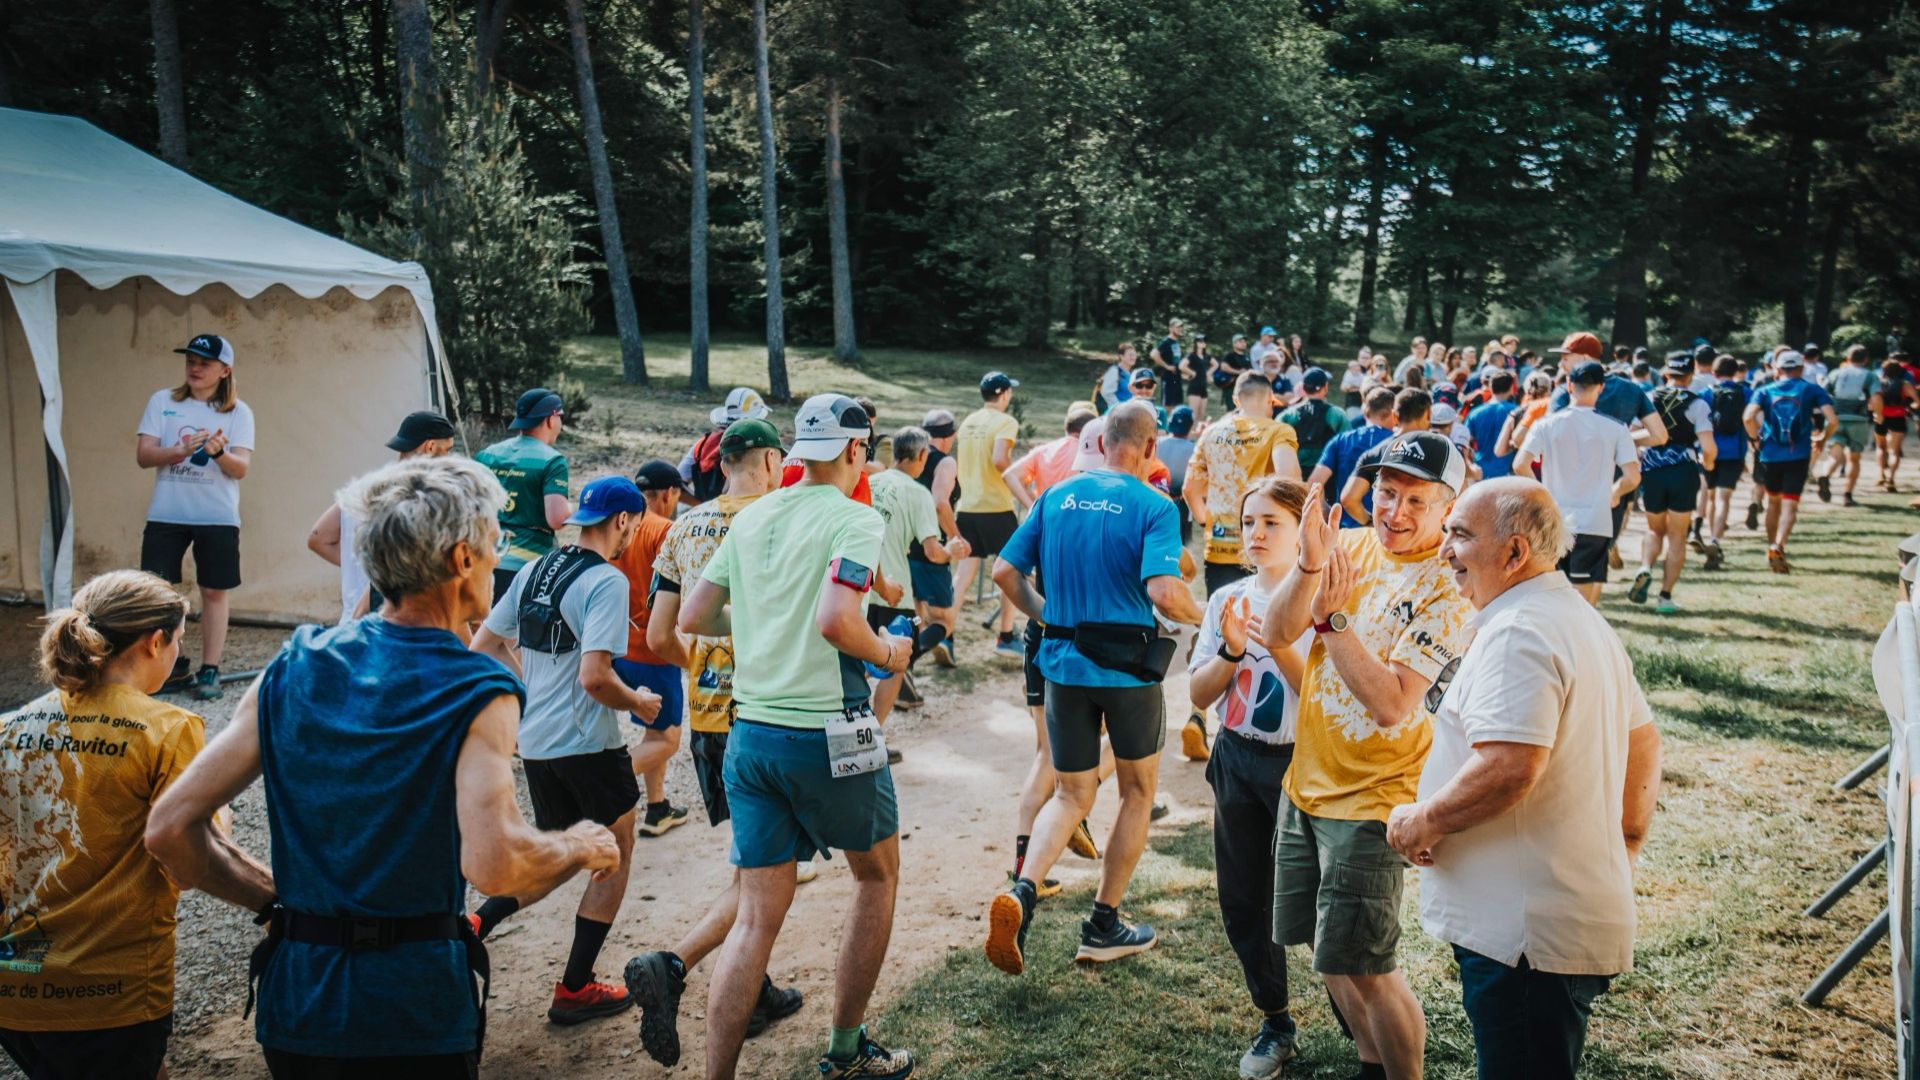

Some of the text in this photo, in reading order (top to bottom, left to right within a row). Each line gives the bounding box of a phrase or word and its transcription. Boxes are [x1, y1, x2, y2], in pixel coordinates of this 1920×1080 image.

[1079, 500, 1122, 514] odlo
[691, 525, 701, 537] Et
[704, 525, 716, 537] le
[35, 708, 47, 720] de
[48, 711, 69, 722] plus
[71, 715, 98, 723] pour
[100, 714, 110, 724] la
[112, 718, 147, 731] gloire
[16, 733, 128, 757] Et le Ravito!
[857, 728, 873, 745] 50
[0, 980, 123, 999] ac de Devesset
